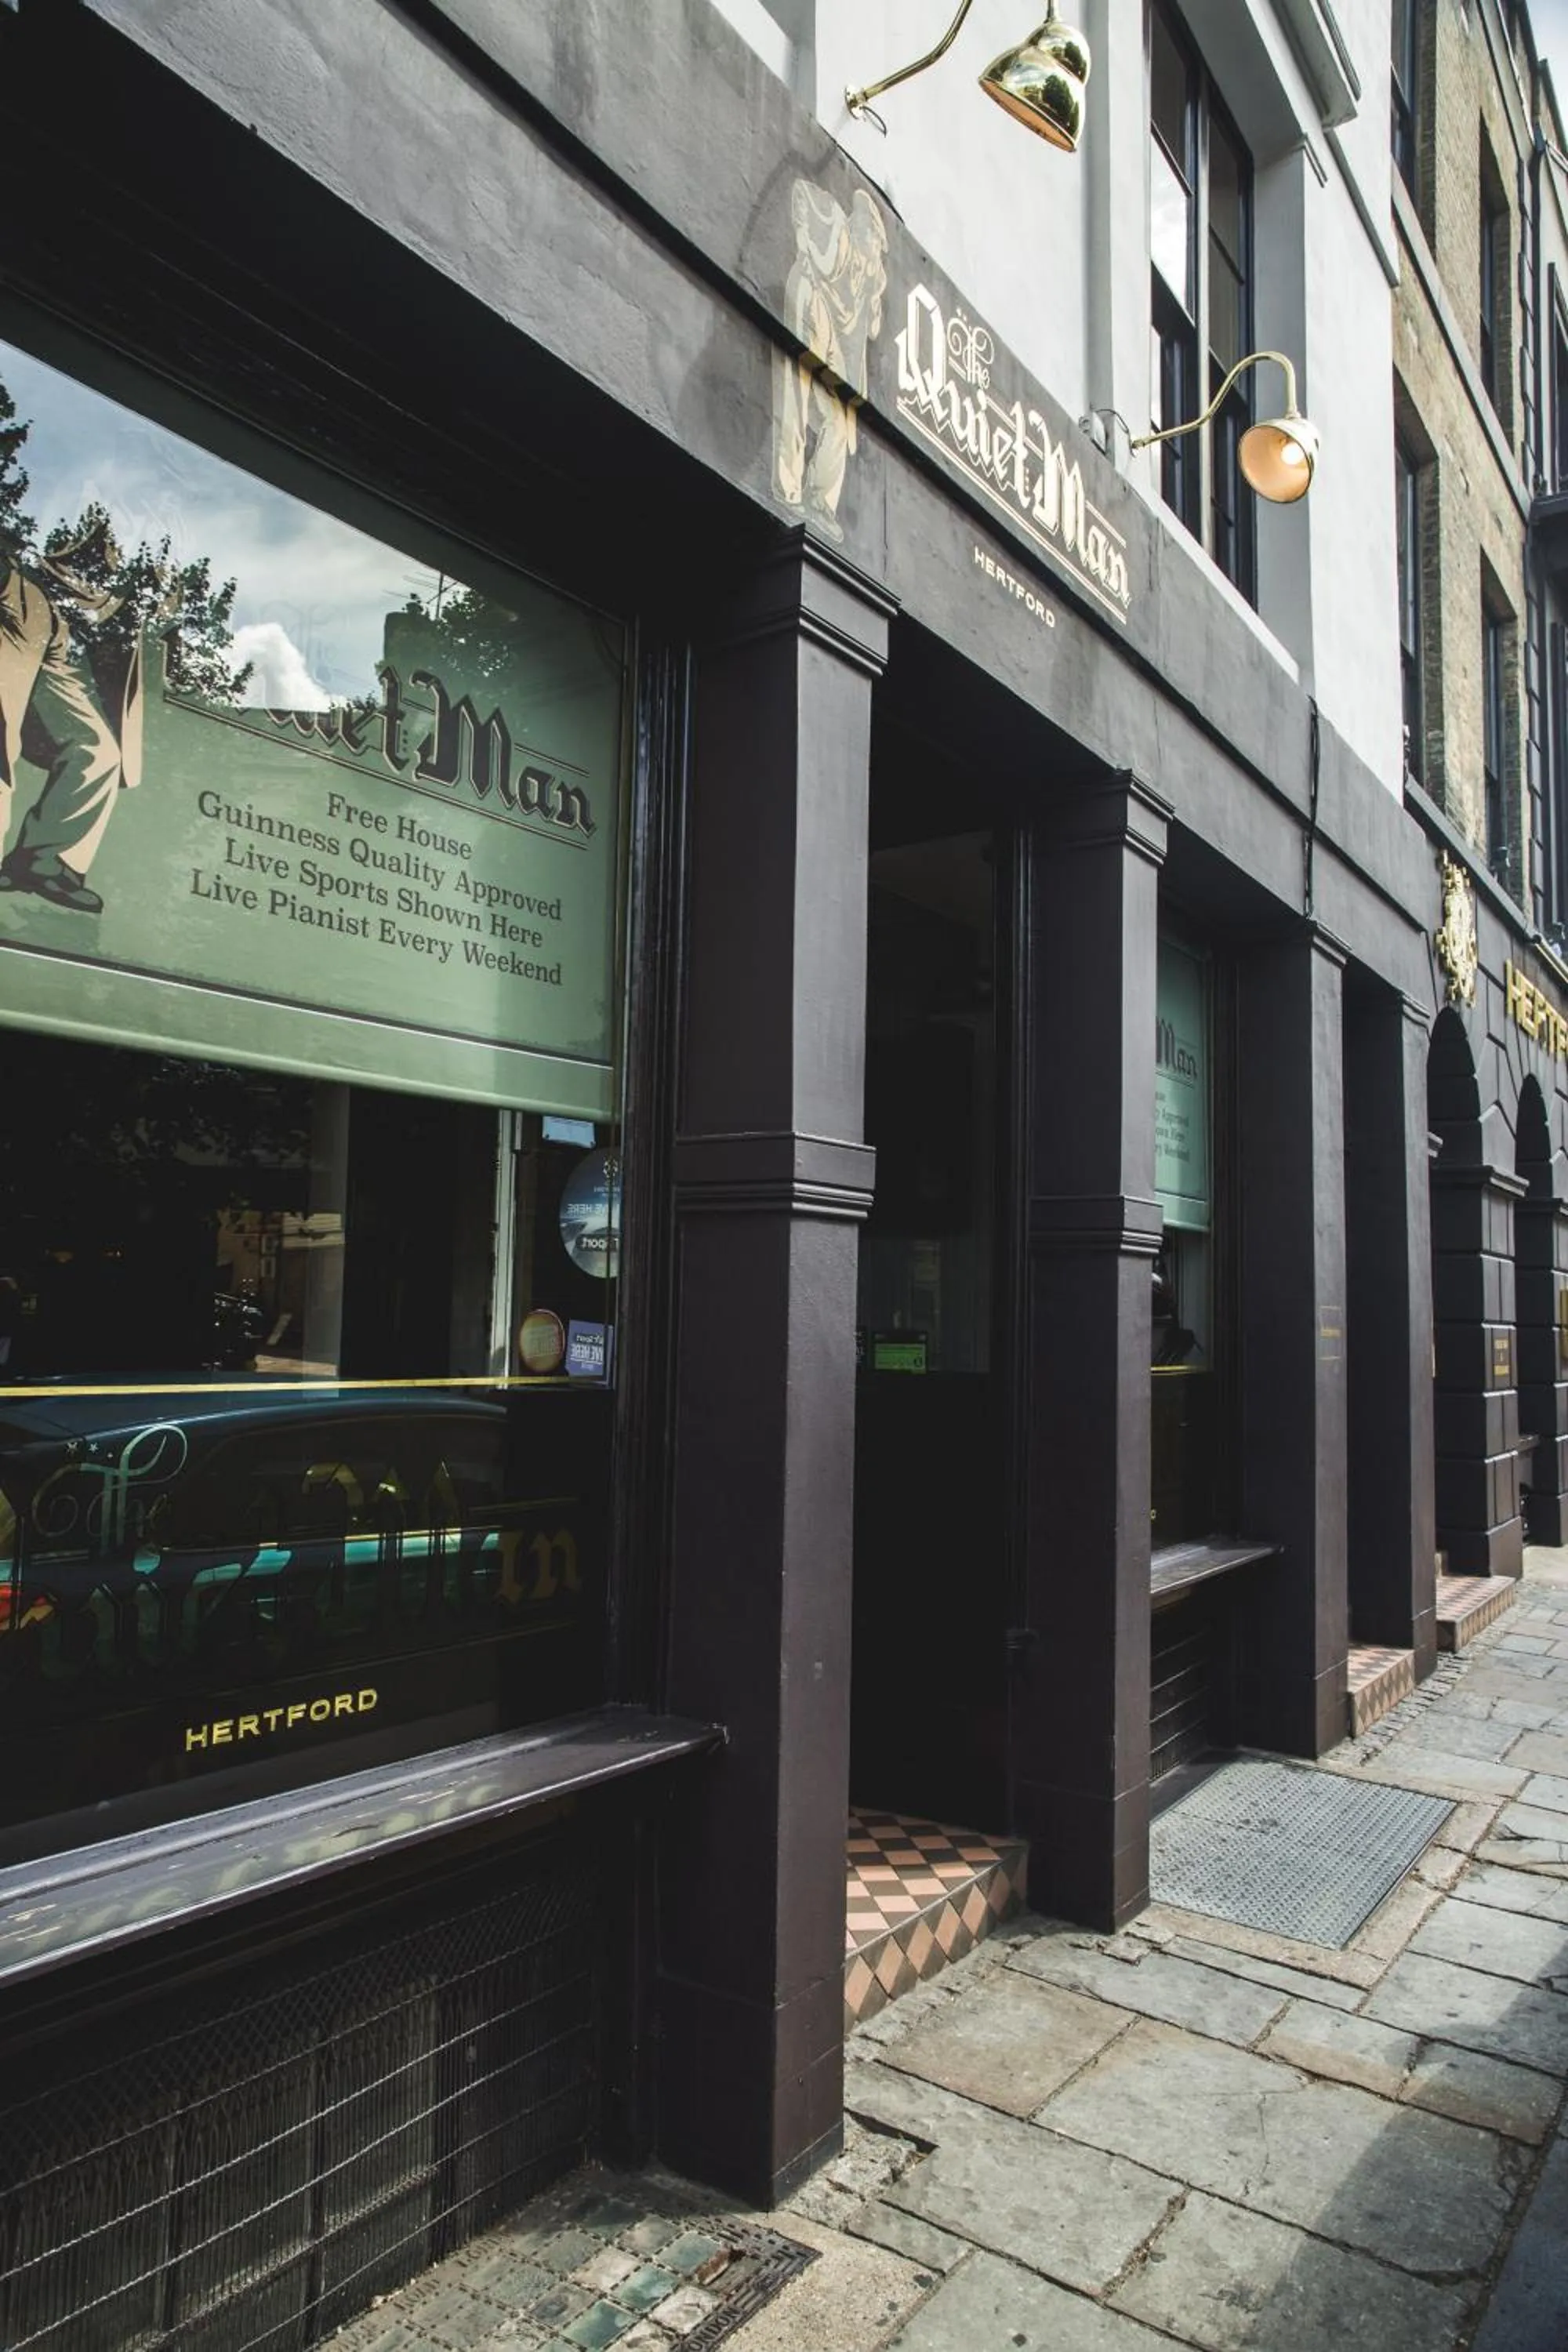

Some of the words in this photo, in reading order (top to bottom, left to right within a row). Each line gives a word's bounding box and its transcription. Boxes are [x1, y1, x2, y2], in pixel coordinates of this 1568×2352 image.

[946, 317, 994, 390] The
[895, 283, 1031, 508] Quiet
[1028, 408, 1133, 609] Man
[975, 546, 1056, 628] HERTFORD
[409, 669, 597, 837] Man
[198, 789, 340, 855] Guinness
[350, 837, 446, 891] Quality
[454, 870, 562, 921] Approved
[326, 791, 389, 833] Free
[396, 815, 473, 860] House
[190, 867, 259, 909] Live
[267, 887, 372, 938] Pianist
[378, 917, 454, 964] Every
[461, 939, 563, 986] Weekend
[223, 836, 290, 879] Live
[299, 858, 389, 906] Sports
[397, 887, 483, 932] Shown
[489, 913, 543, 948] Here
[1505, 957, 1568, 1061] HERTF
[185, 1687, 379, 1751] HERTFORD
[682, 2305, 742, 2352] ONDON
